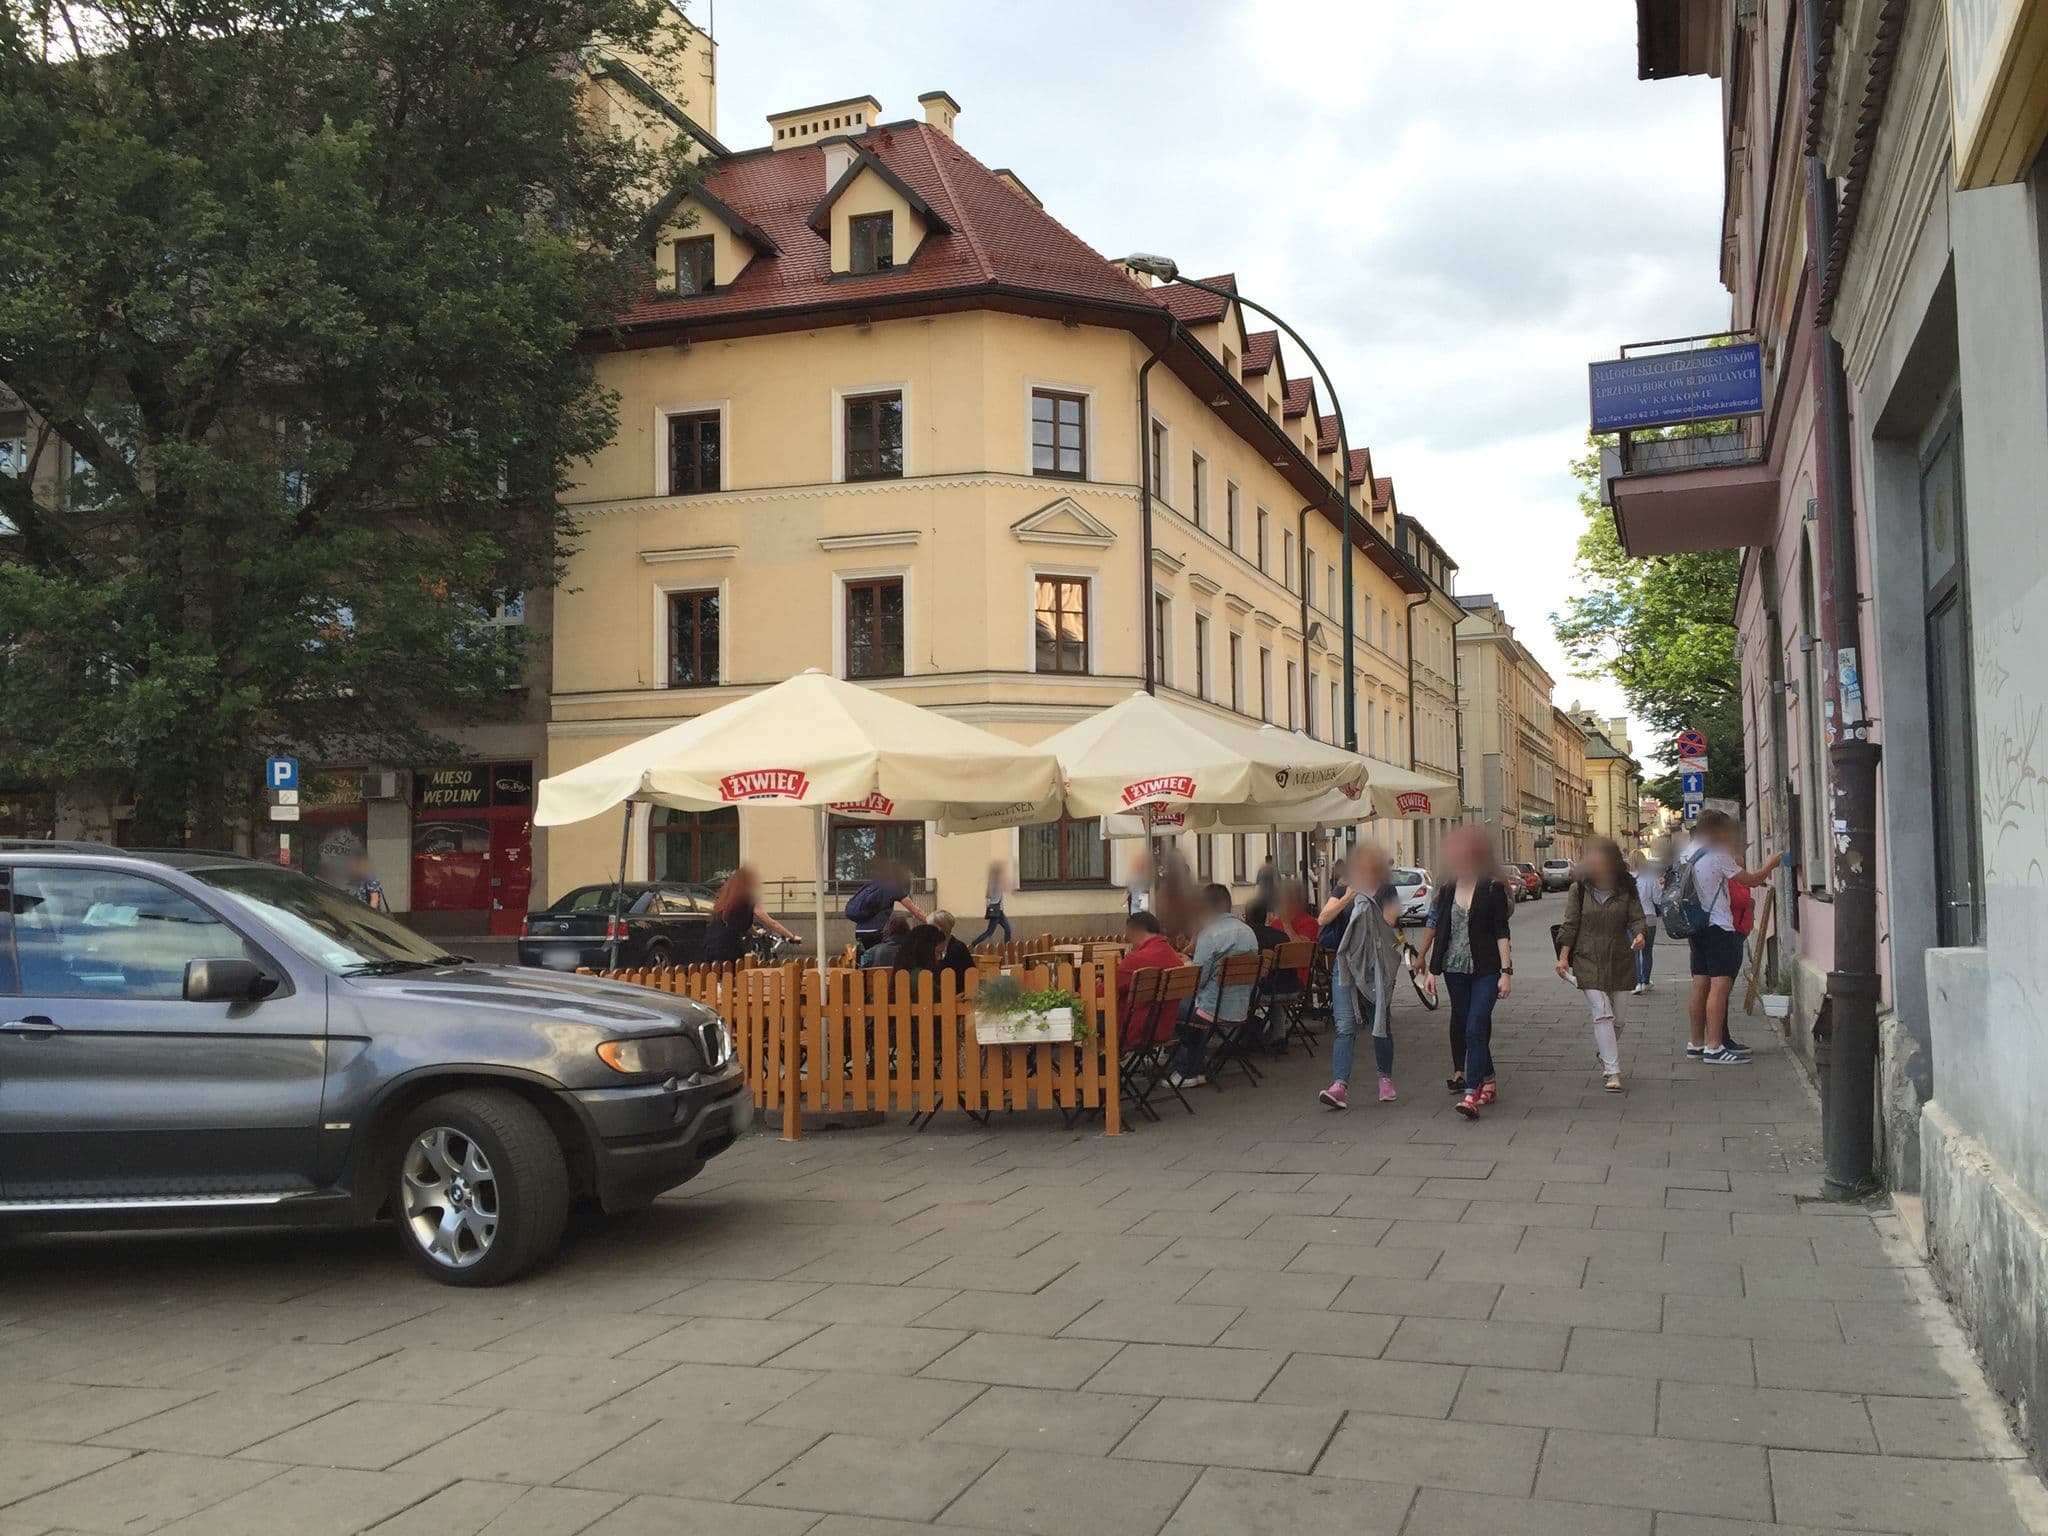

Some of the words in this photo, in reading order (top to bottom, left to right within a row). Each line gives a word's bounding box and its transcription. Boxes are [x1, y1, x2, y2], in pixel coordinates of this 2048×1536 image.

[1686, 368, 1757, 386] BUDOWLANYCH
[1652, 389, 1713, 405] KRAKOWIE
[274, 762, 291, 786] P
[728, 772, 799, 796] ŻYWIEC
[1130, 777, 1188, 798] ŻYWIEC
[423, 789, 481, 806] WĘDLINY
[1399, 793, 1427, 809] ŻYWIEC
